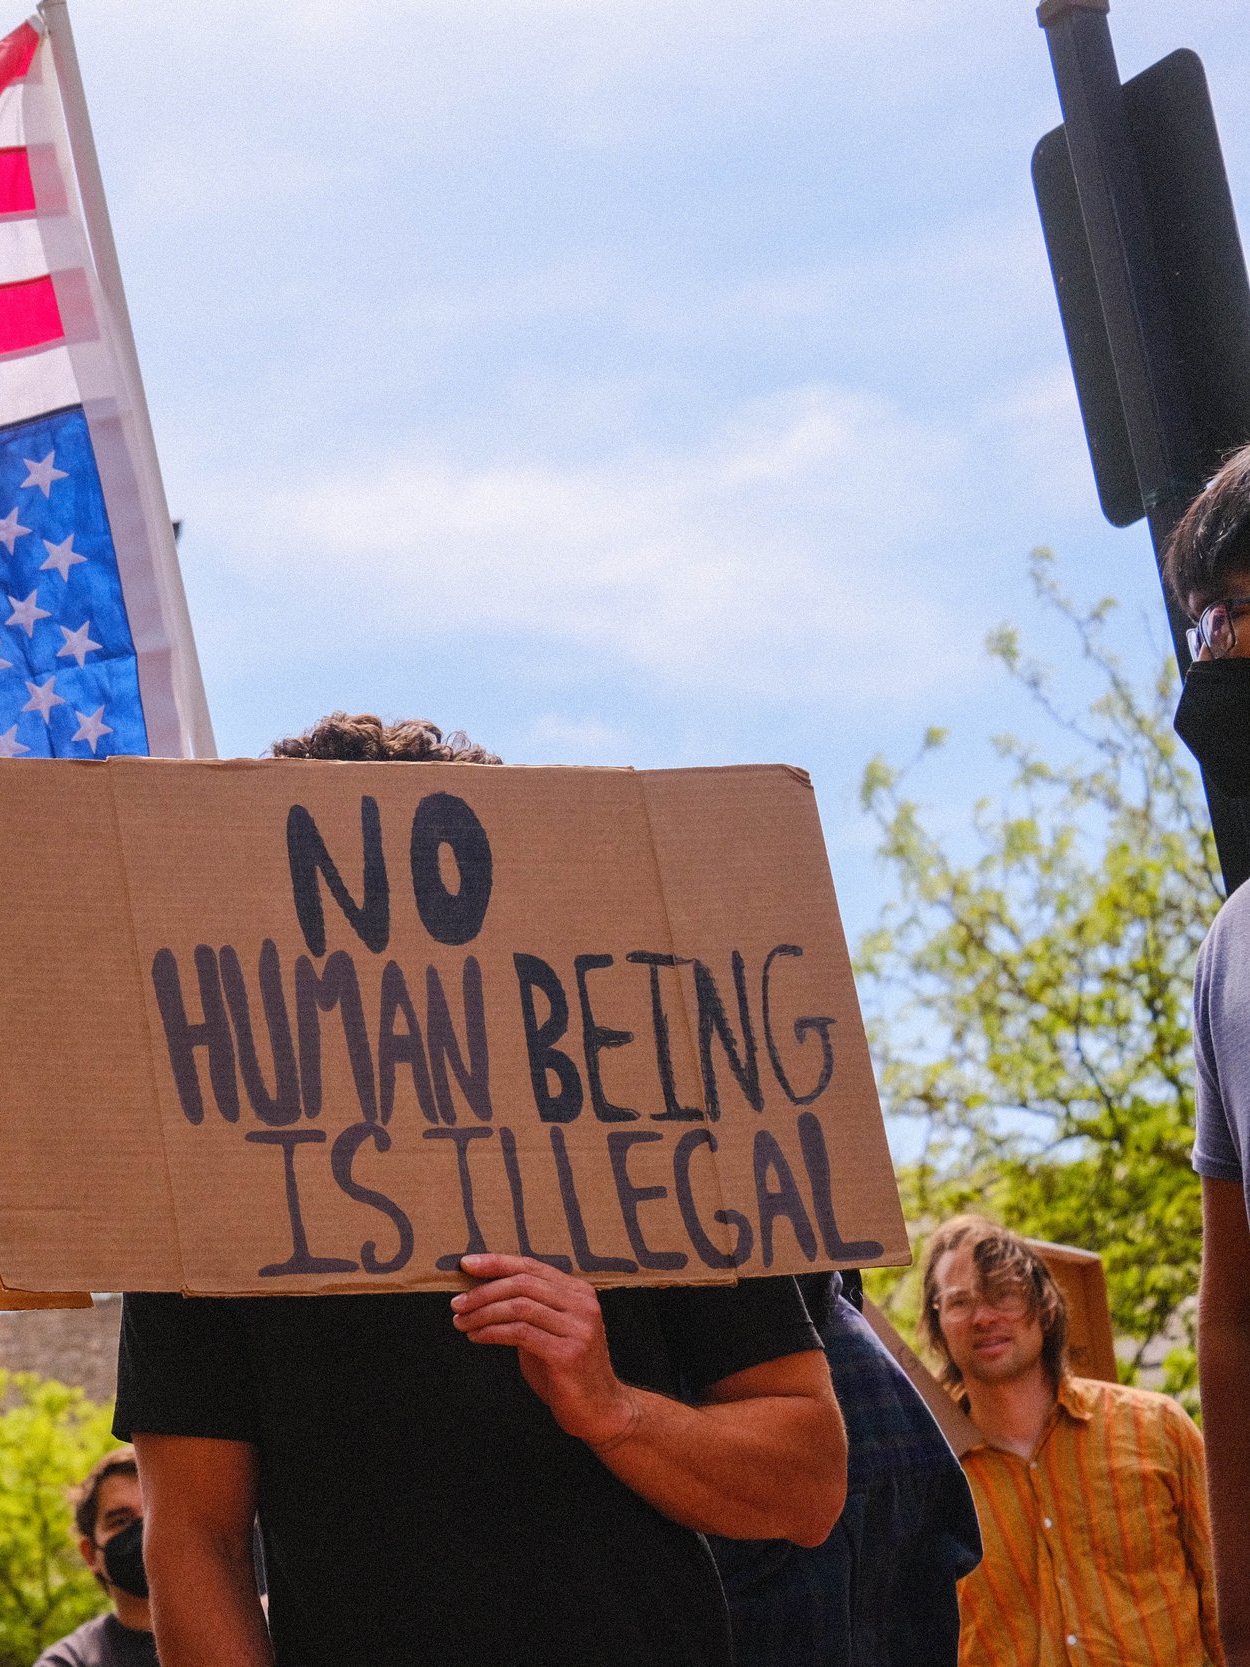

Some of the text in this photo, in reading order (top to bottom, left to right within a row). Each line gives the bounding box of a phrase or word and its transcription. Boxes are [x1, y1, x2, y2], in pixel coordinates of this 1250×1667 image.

[286, 790, 493, 957] NO
[152, 938, 838, 1126] HUMAN BEING
[243, 1111, 885, 1277] IS ILLEGAL
